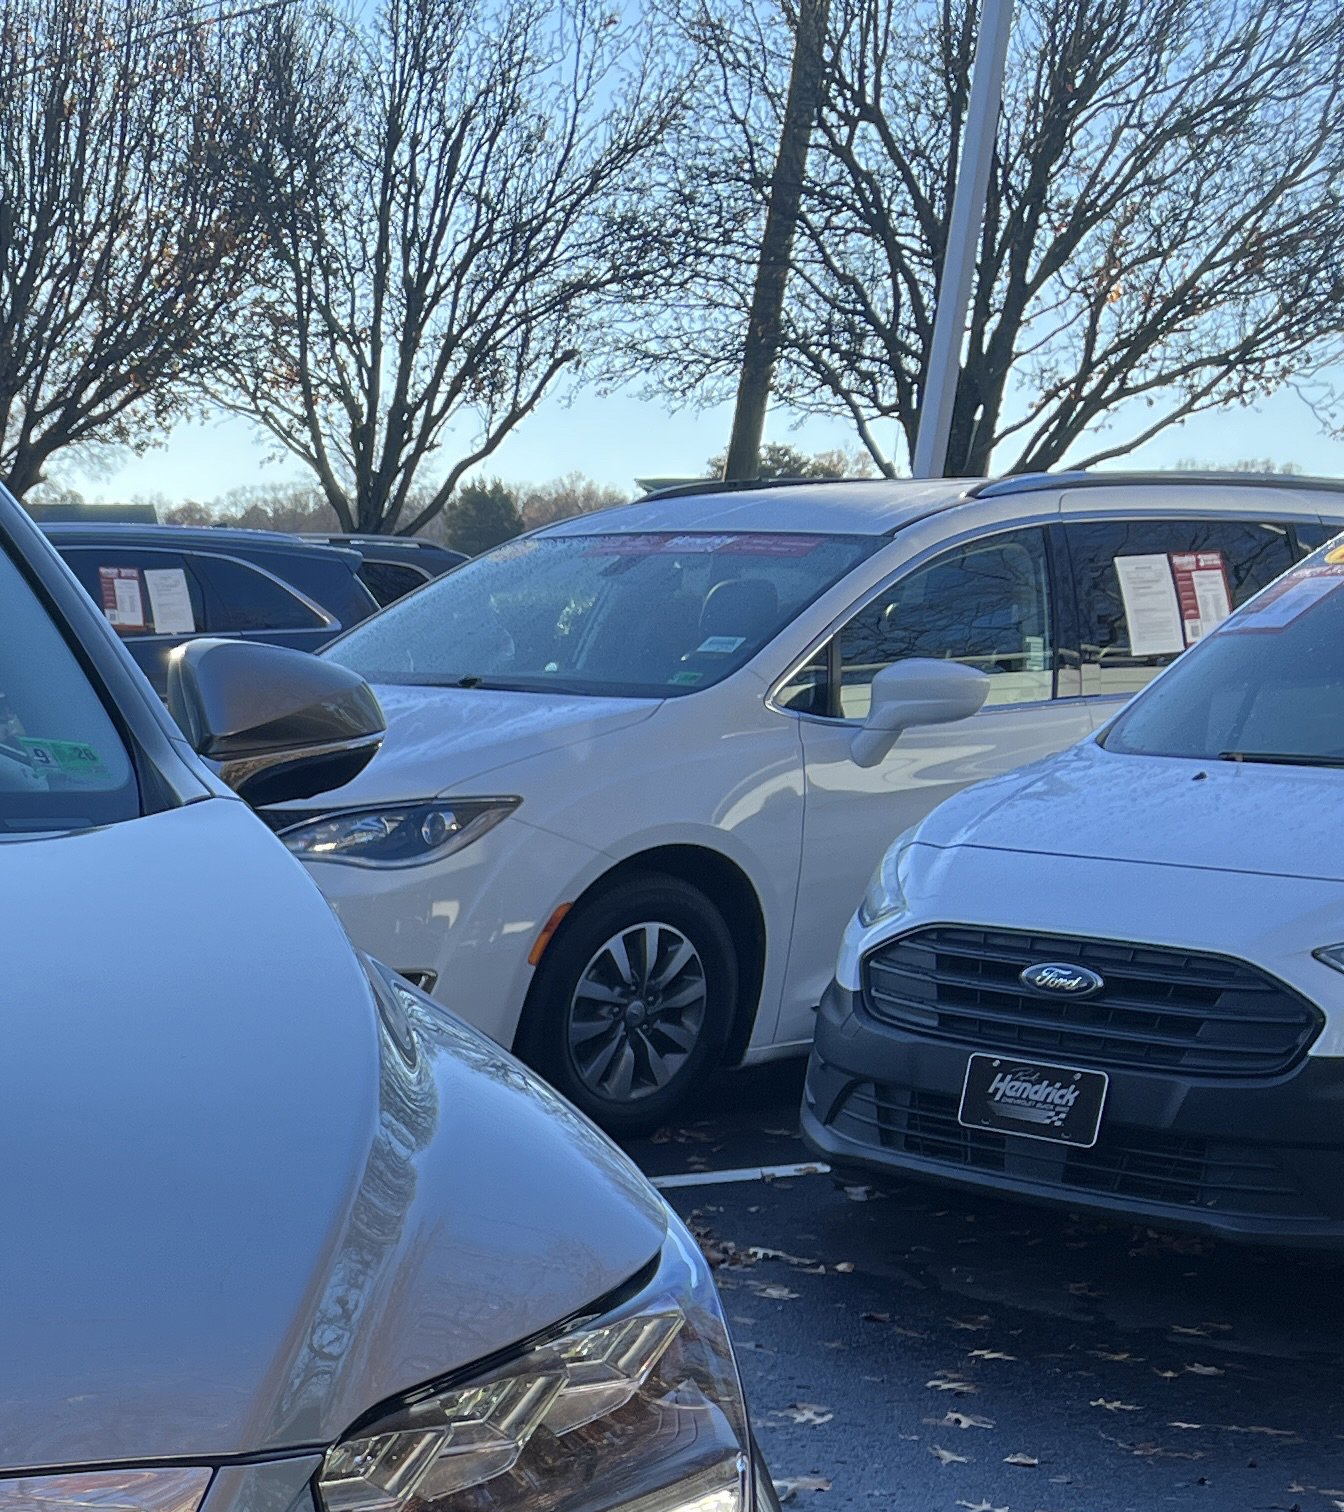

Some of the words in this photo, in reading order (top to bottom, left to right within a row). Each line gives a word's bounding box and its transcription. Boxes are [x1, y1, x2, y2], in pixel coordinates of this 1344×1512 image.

[33, 748, 50, 764] 9
[1035, 966, 1088, 991] Ford
[987, 1072, 1080, 1107] Hendrick
